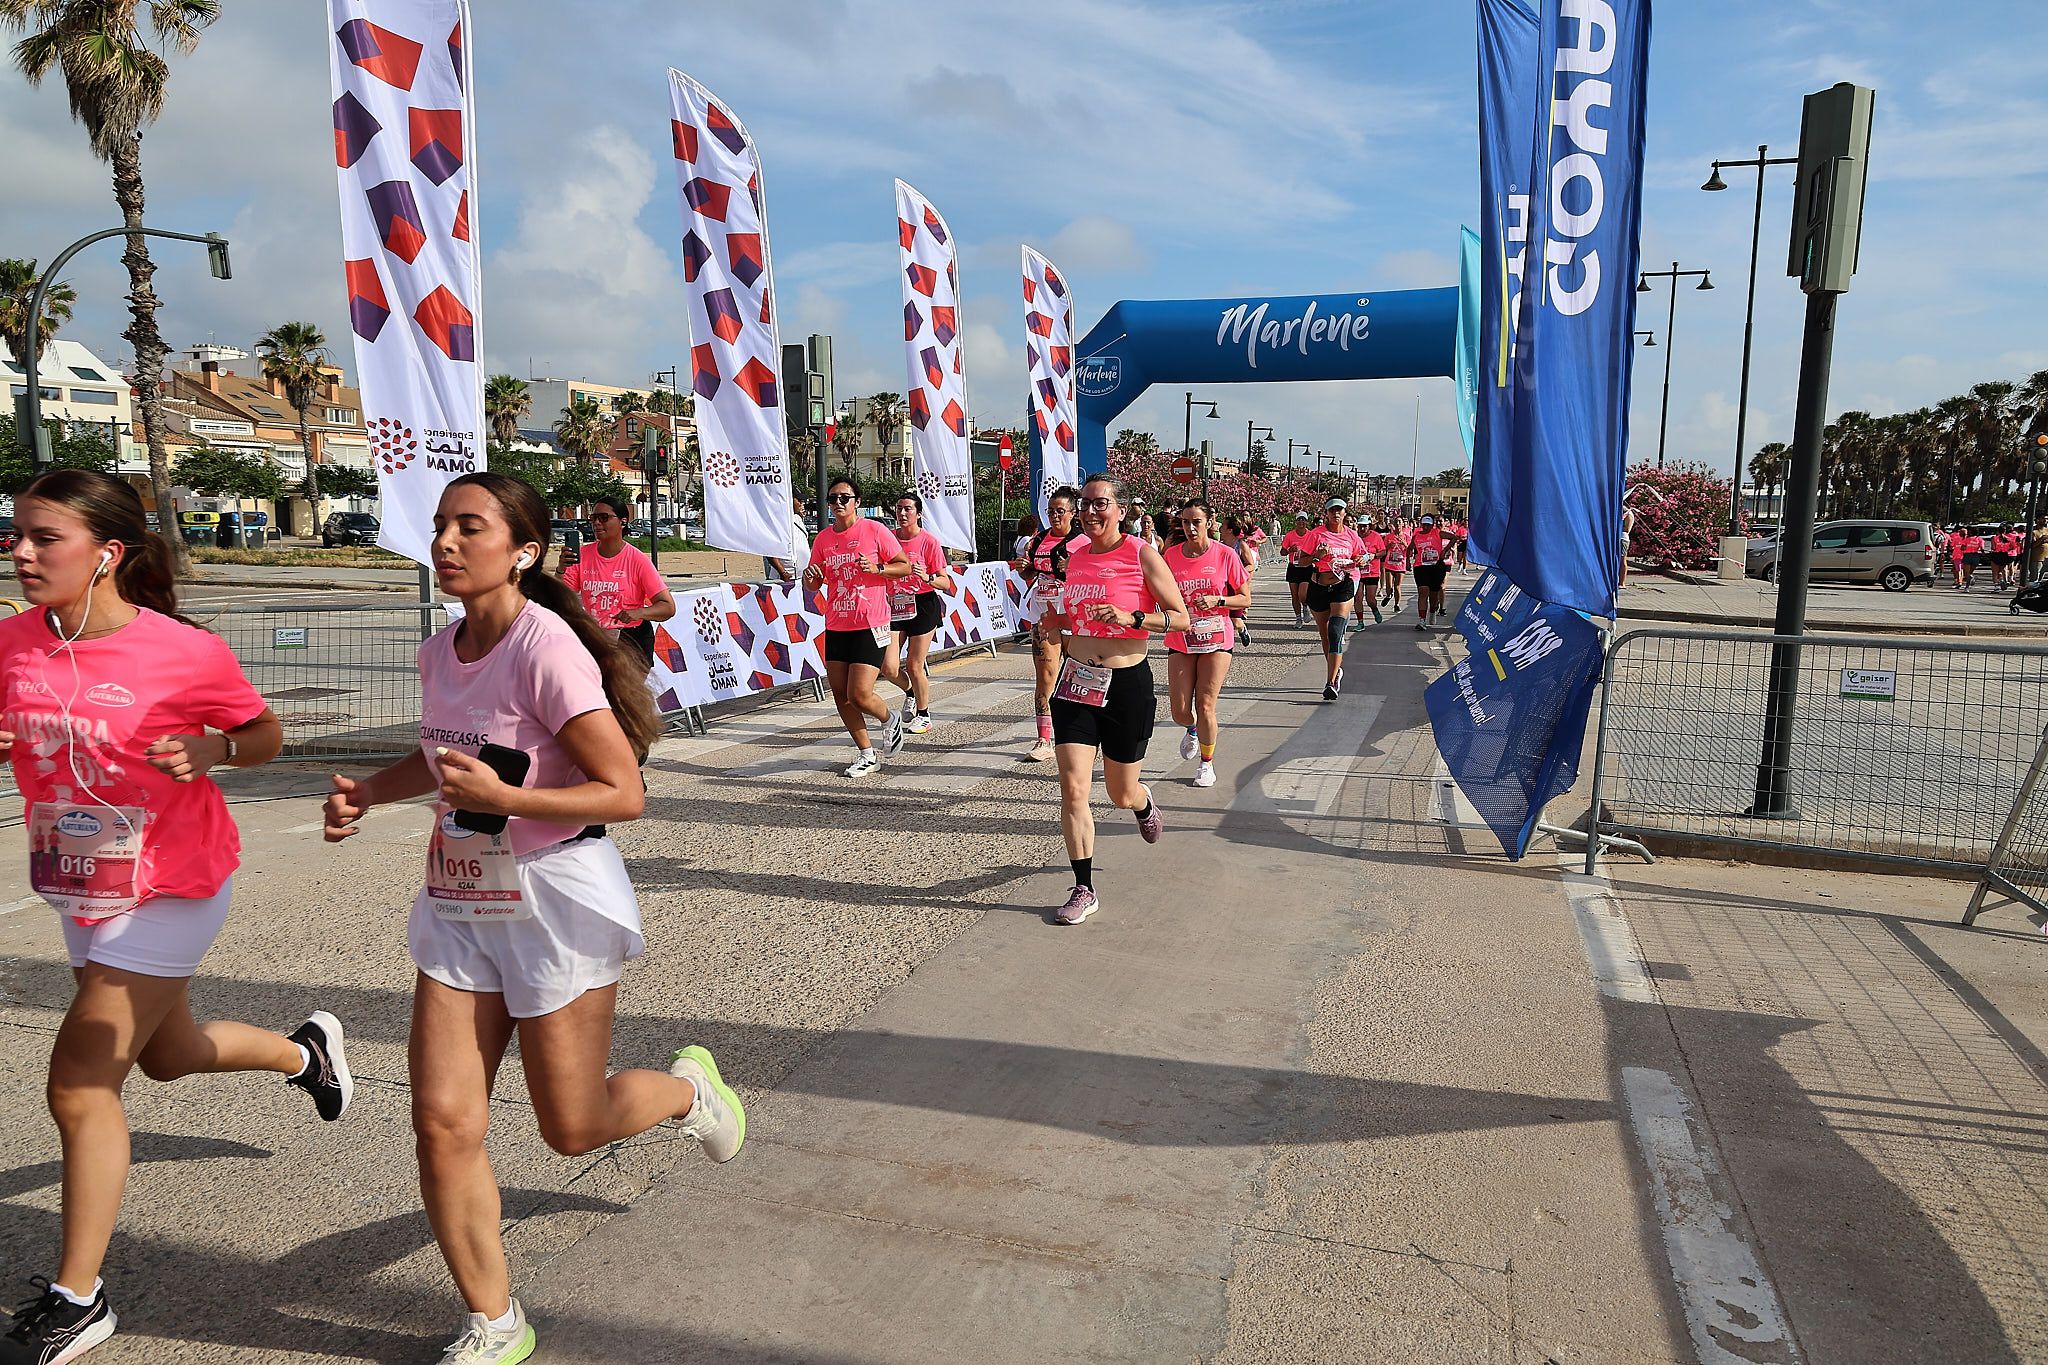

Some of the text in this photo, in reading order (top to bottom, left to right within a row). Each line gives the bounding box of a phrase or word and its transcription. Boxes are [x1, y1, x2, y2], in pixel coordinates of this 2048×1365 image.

[1217, 300, 1370, 369] Marlene
[1075, 365, 1118, 385] Marlene
[583, 580, 619, 593] CARRERA
[1066, 584, 1106, 599] ARRERA
[1197, 632, 1213, 640] 016
[711, 676, 738, 690] OMAN
[1070, 683, 1089, 696] 016
[421, 726, 489, 747] CUATRECASAS
[60, 855, 97, 876] 016
[446, 858, 483, 878] 016
[458, 881, 476, 890] 4244
